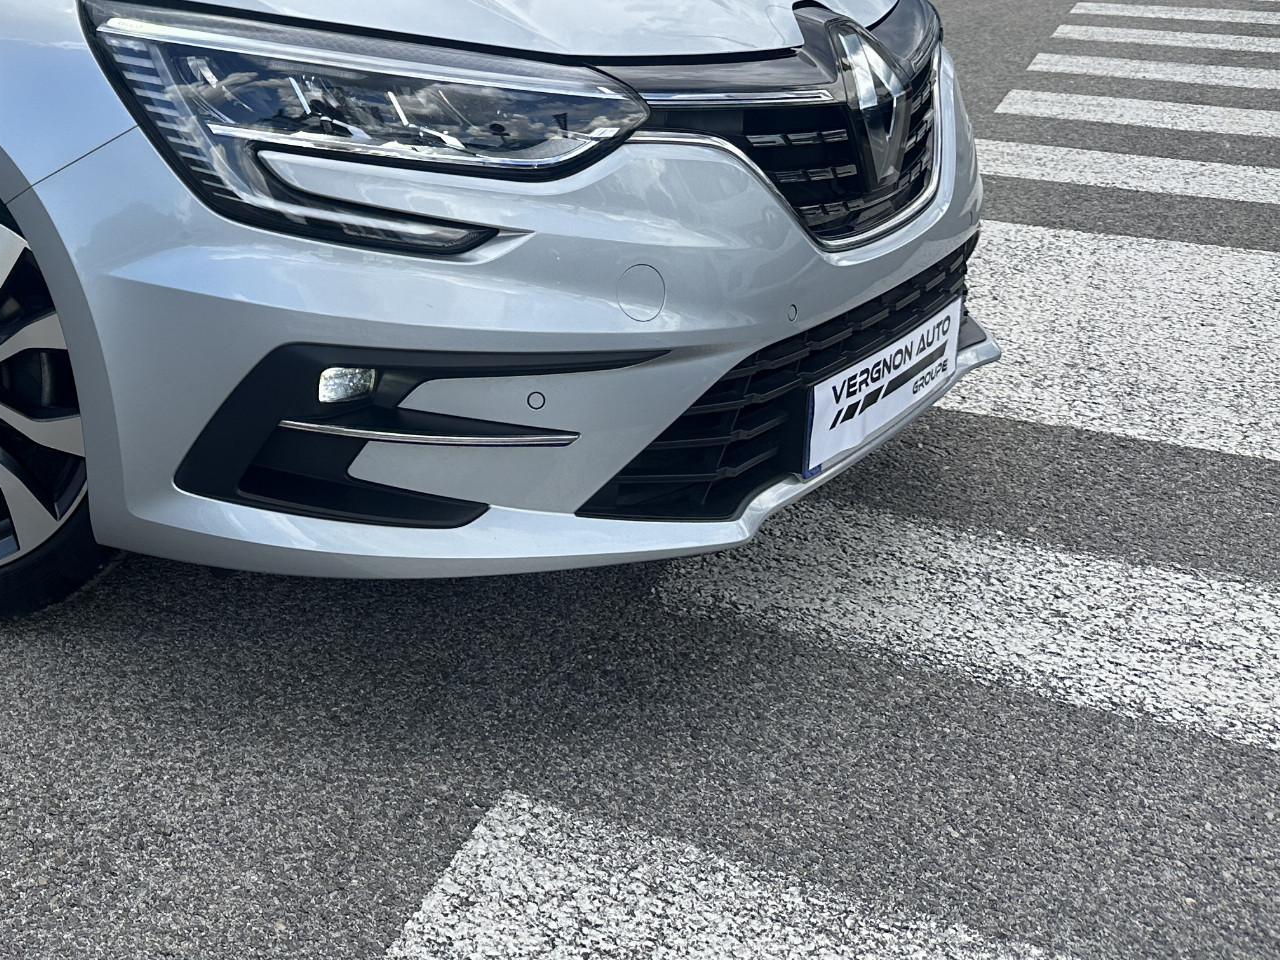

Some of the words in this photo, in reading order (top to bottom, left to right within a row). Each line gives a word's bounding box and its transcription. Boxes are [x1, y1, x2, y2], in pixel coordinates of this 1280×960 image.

[831, 340, 914, 405] VERGNON
[916, 314, 951, 356] AUTO
[912, 358, 949, 395] GROUPE
